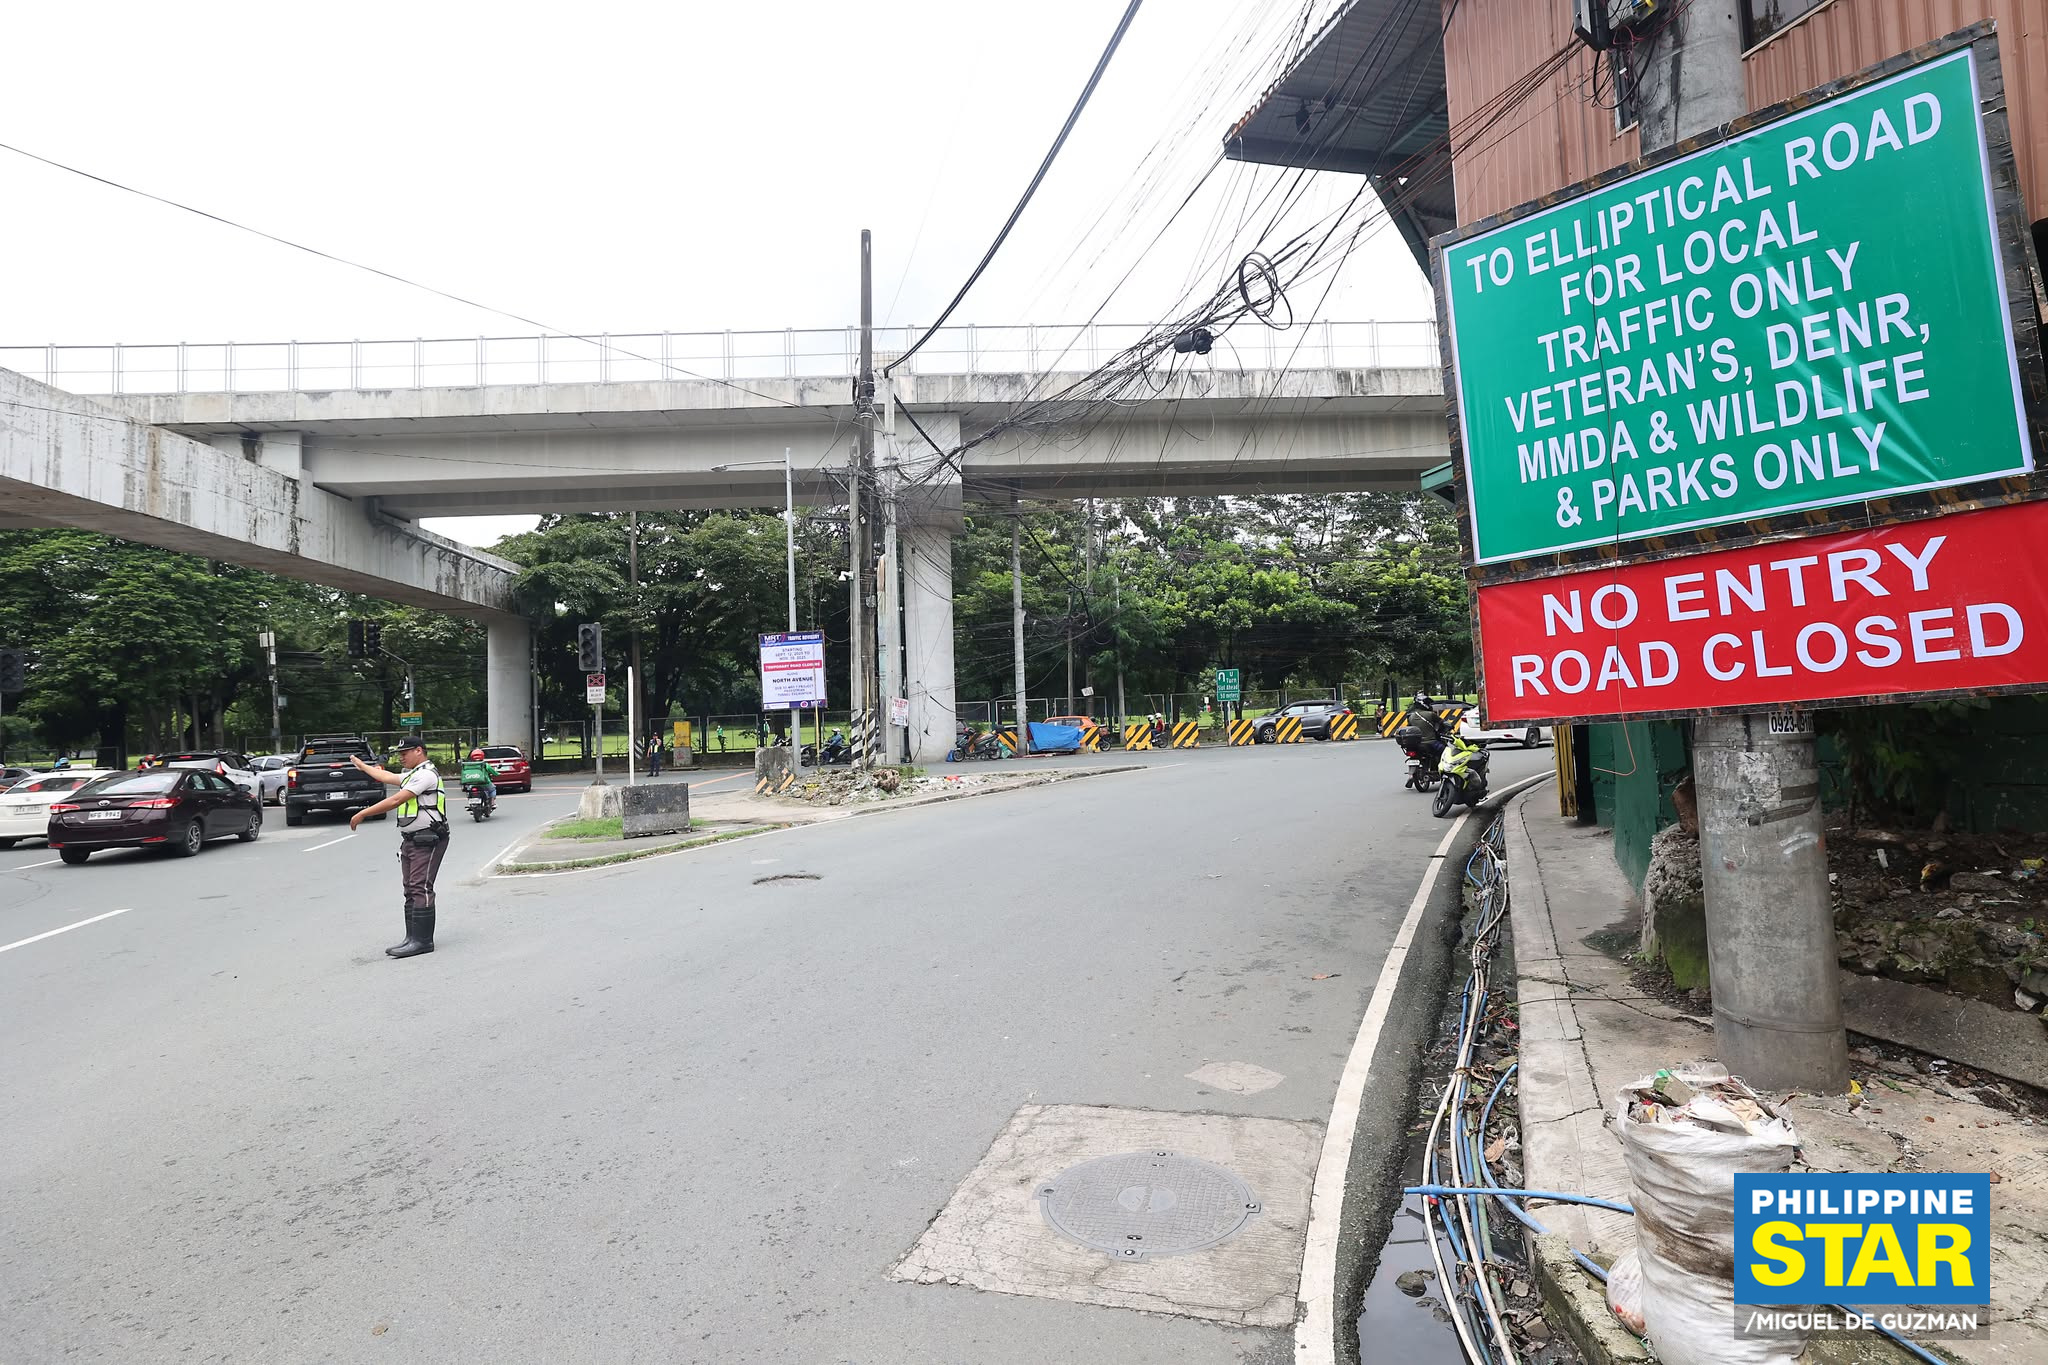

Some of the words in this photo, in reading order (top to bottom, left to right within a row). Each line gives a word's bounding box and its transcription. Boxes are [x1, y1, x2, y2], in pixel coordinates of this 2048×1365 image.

[1466, 247, 1514, 294] TO
[1525, 156, 1772, 276] ELLIPTICAL
[1784, 92, 1942, 187] ROAD
[1537, 286, 1715, 373] TRAFFIC
[1729, 241, 1861, 319] ONLY
[1560, 253, 1645, 316] FOR
[1656, 200, 1819, 286] LOCAL
[1504, 337, 1753, 433] VETERAN'S,
[1766, 292, 1930, 370] DENR,
[1517, 420, 1639, 484] MMDA
[1649, 410, 1678, 454] &
[1686, 350, 1930, 445] WILDLIFE
[1556, 486, 1583, 528] &
[1591, 453, 1739, 522] PARKS
[1753, 421, 1887, 490] ONLY
[1542, 583, 1639, 637] NO
[1663, 535, 1947, 622] ENTRY
[1511, 640, 1679, 698] ROAD
[1702, 602, 2024, 681] CLOSED
